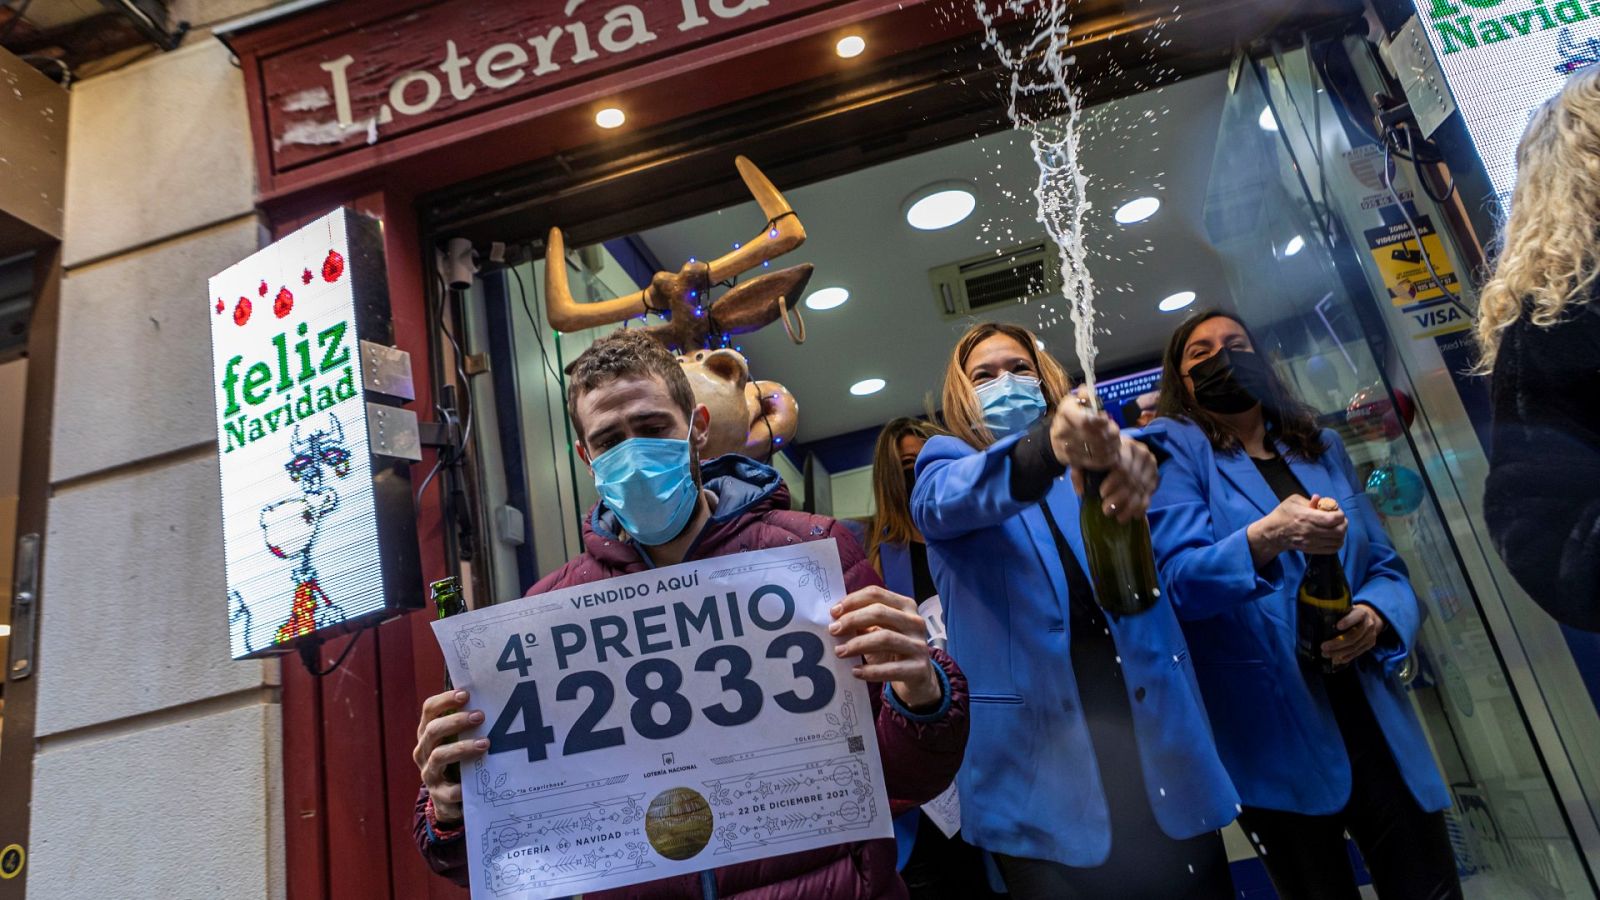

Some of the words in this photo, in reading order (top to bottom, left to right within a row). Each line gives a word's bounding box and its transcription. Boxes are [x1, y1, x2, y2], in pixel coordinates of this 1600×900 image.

[320, 0, 657, 124] Lotería
[1376, 226, 1429, 245] VIDEOVIGILDA
[1413, 307, 1461, 328] VISA
[223, 321, 350, 418] feliz
[1107, 391, 1118, 400] DE
[1120, 382, 1152, 396] NAVIDAD
[224, 365, 357, 453] Navidad
[571, 583, 650, 610] VENDIDO
[656, 569, 699, 594] AQUÍ
[495, 632, 539, 678] 4º
[551, 584, 796, 670] PREMIO
[487, 631, 836, 763] 42833
[794, 733, 821, 743] TOLEDO
[643, 768, 667, 779] LOTERÍA
[668, 764, 697, 774] NACIONAL
[738, 807, 749, 815] 22
[752, 803, 766, 813] DE
[769, 793, 823, 809] DICIEMBRE
[826, 789, 849, 801] 2021
[507, 844, 551, 859] LOTERÍA
[576, 831, 622, 846] NAVIDAD
